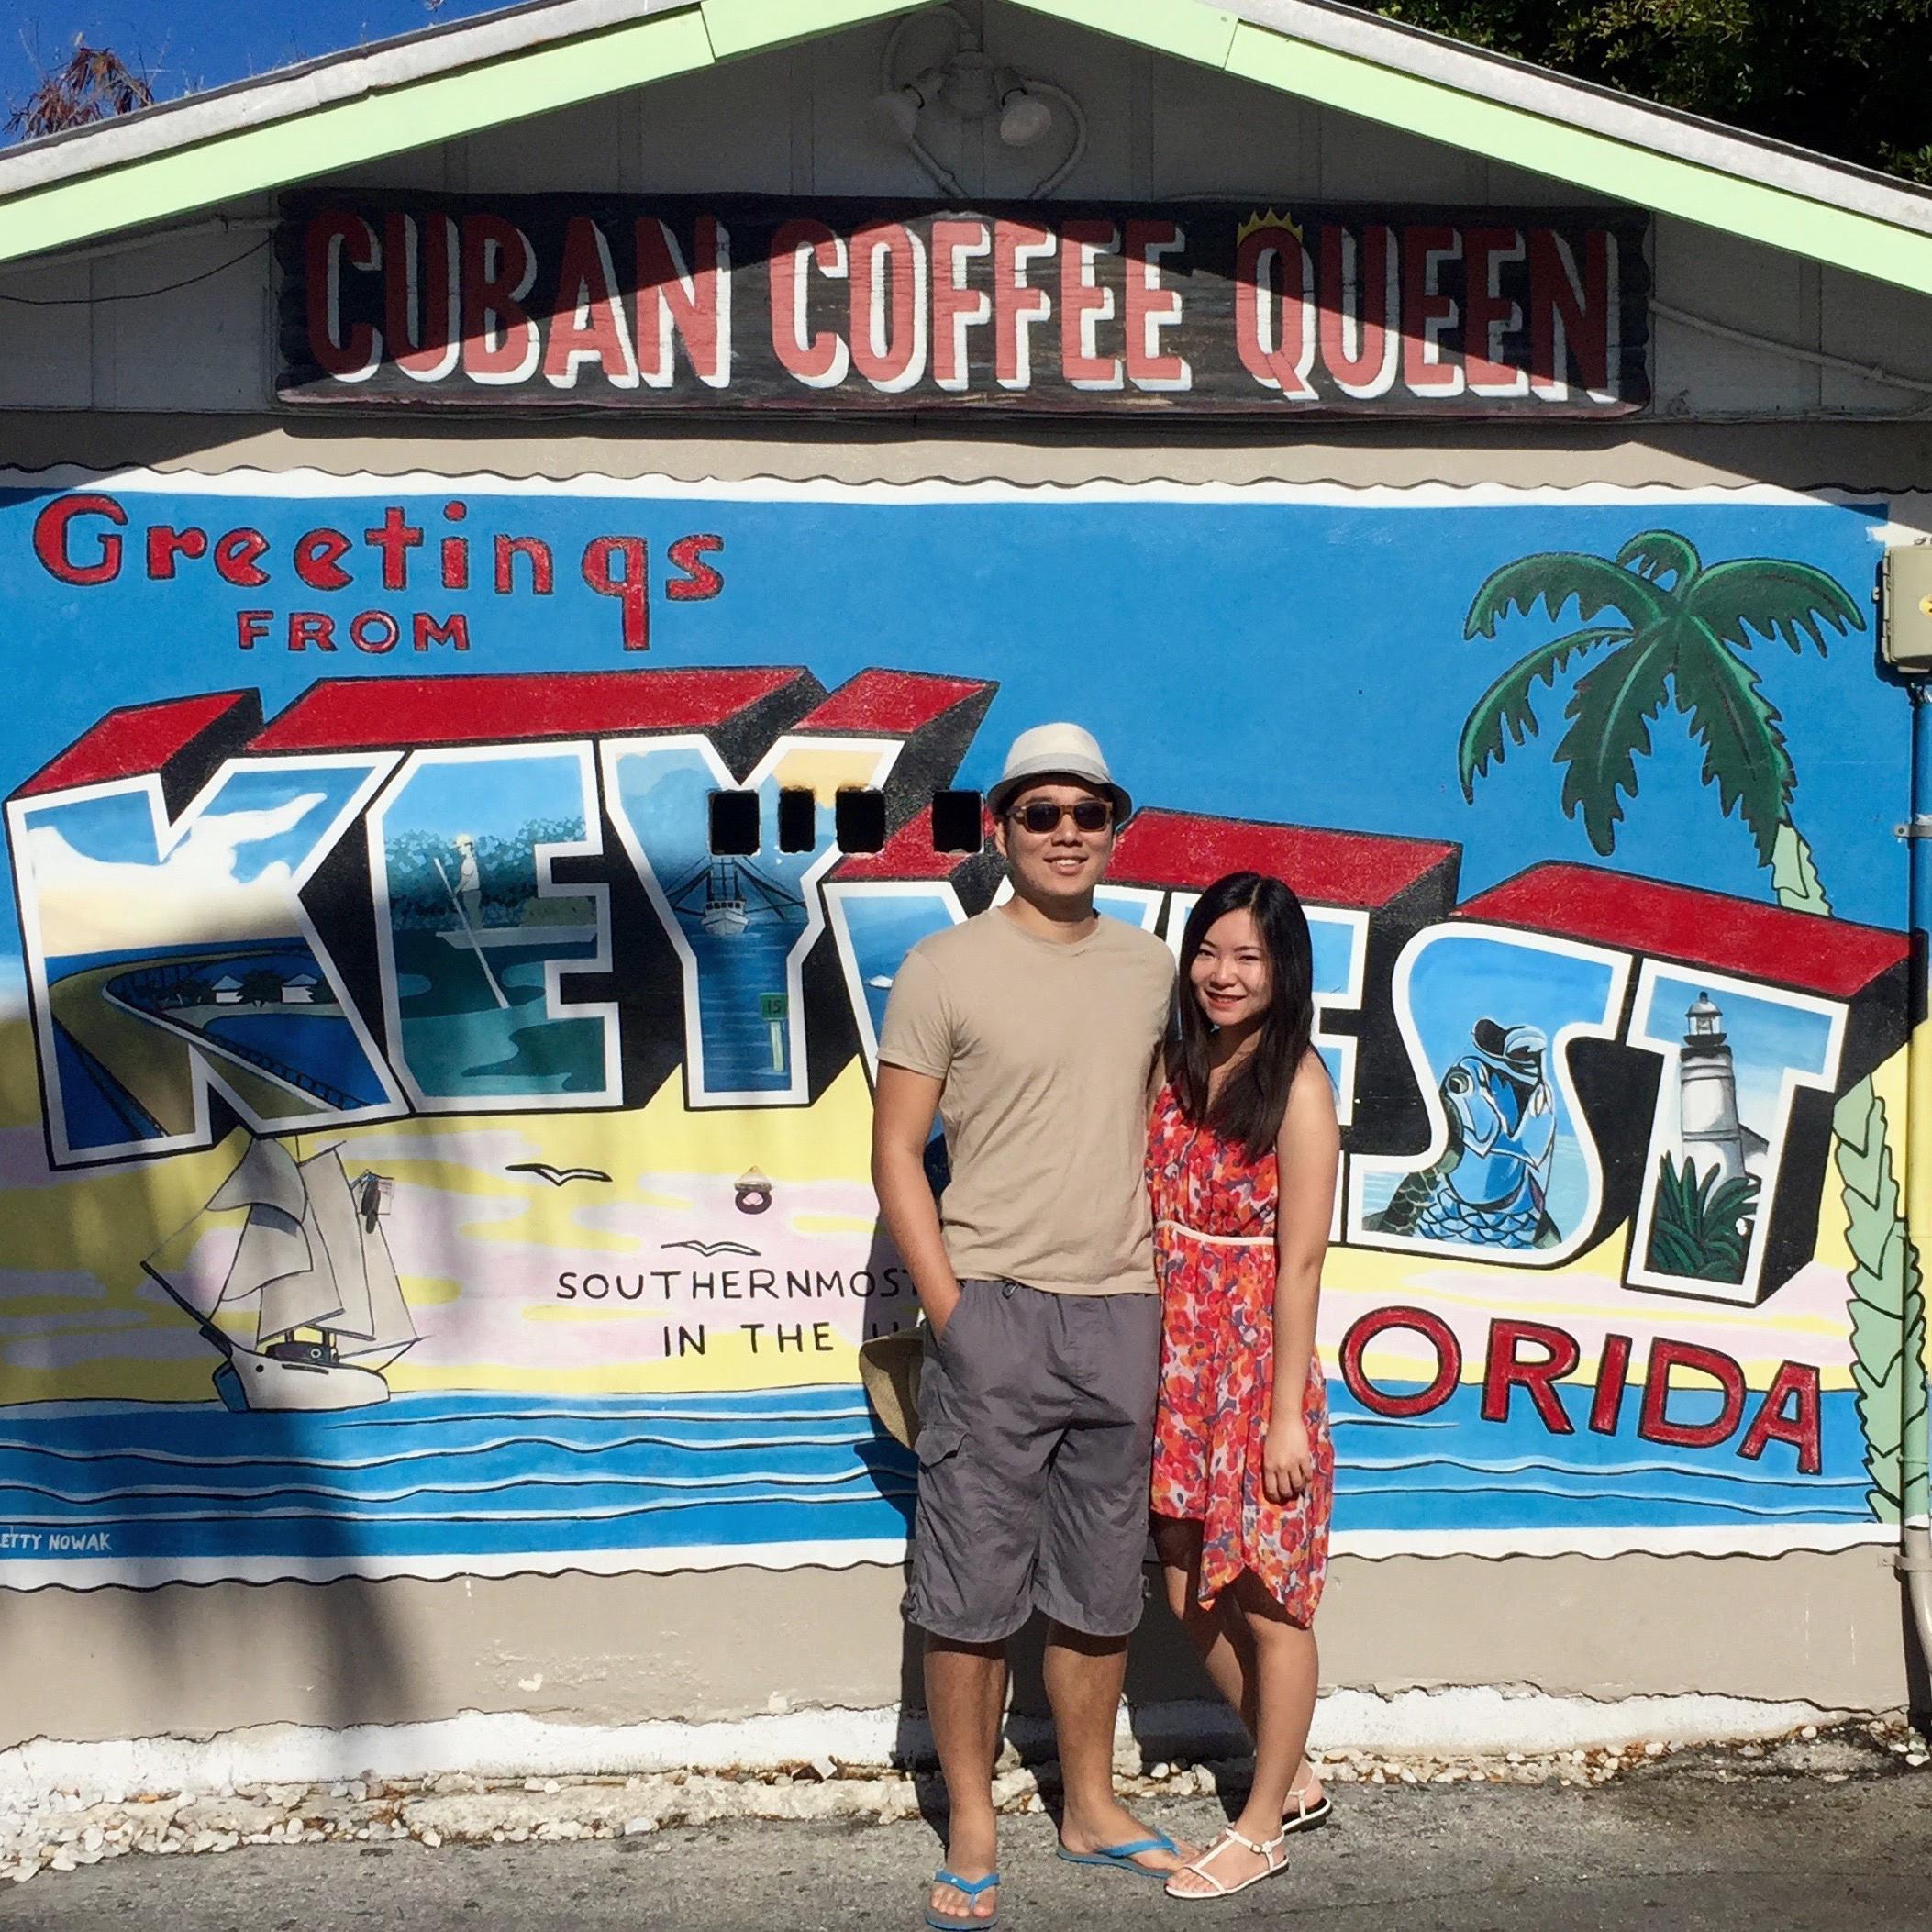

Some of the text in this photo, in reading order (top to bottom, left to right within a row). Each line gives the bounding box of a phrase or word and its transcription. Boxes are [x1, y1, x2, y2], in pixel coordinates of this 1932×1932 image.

[305, 211, 1619, 404] CUBAN COFFEE QUEEN
[237, 609, 471, 653] FROM
[6, 699, 945, 1171] KEY
[662, 1323, 705, 1357] IN
[739, 1321, 834, 1354] THE
[1338, 1305, 1824, 1475] ORIDA
[48, 1532, 112, 1551] NOWAK
